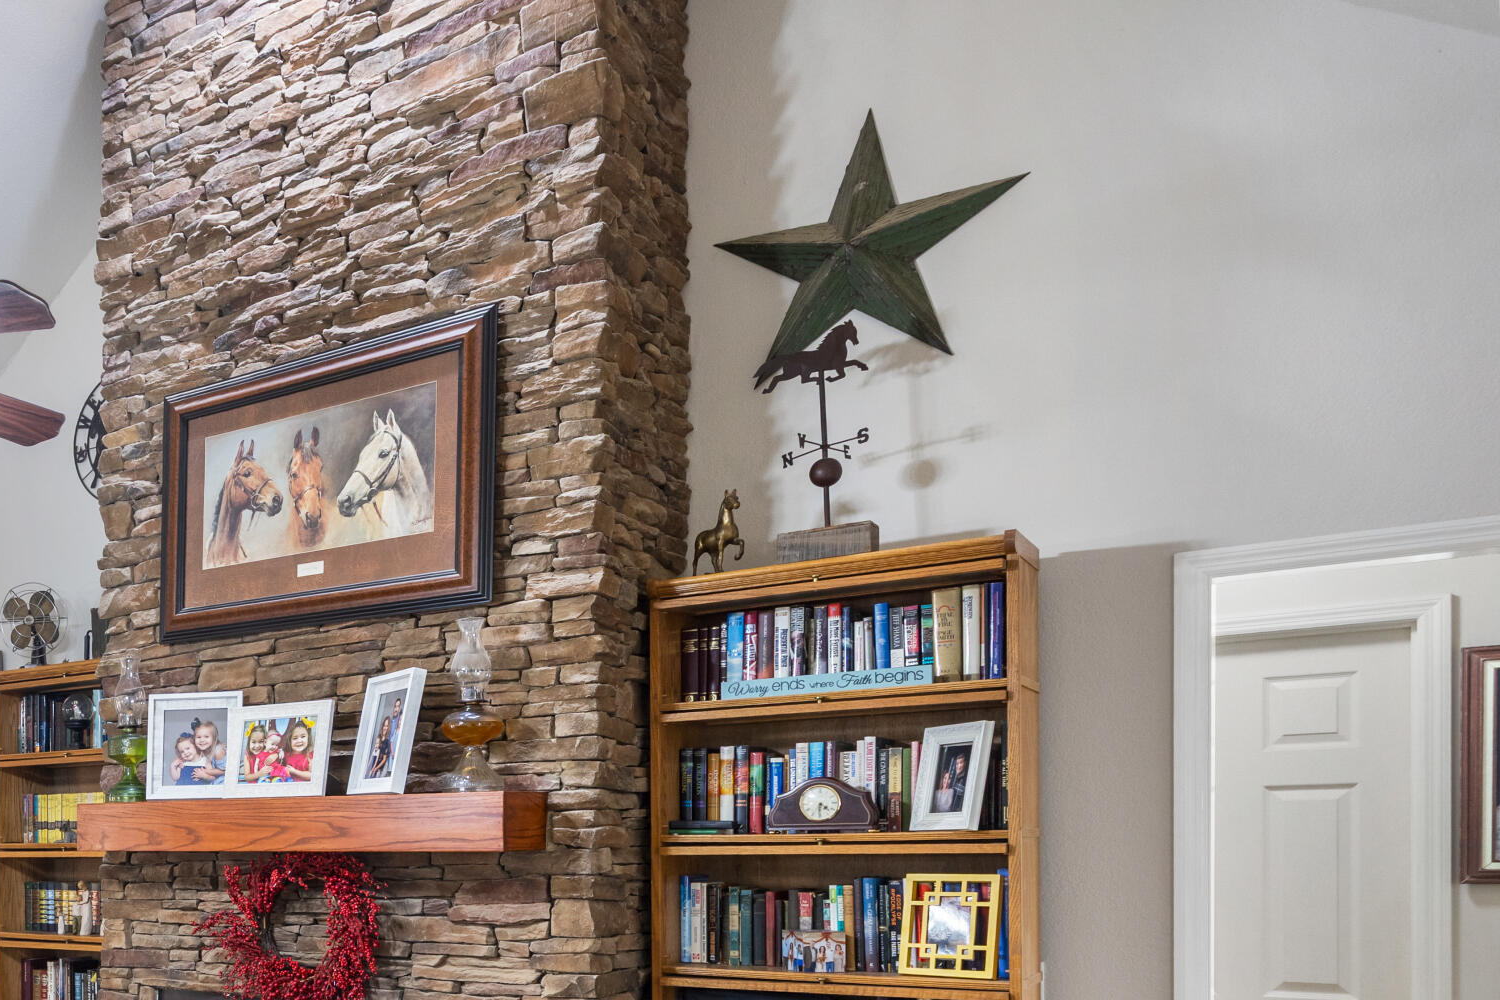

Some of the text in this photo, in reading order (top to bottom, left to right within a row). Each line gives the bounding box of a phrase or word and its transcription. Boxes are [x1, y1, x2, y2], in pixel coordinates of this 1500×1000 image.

[857, 427, 870, 445] S
[781, 451, 794, 469] N
[843, 444, 852, 460] E
[727, 669, 925, 697] Worry ends where Faith begins
[896, 911, 902, 920] OF
